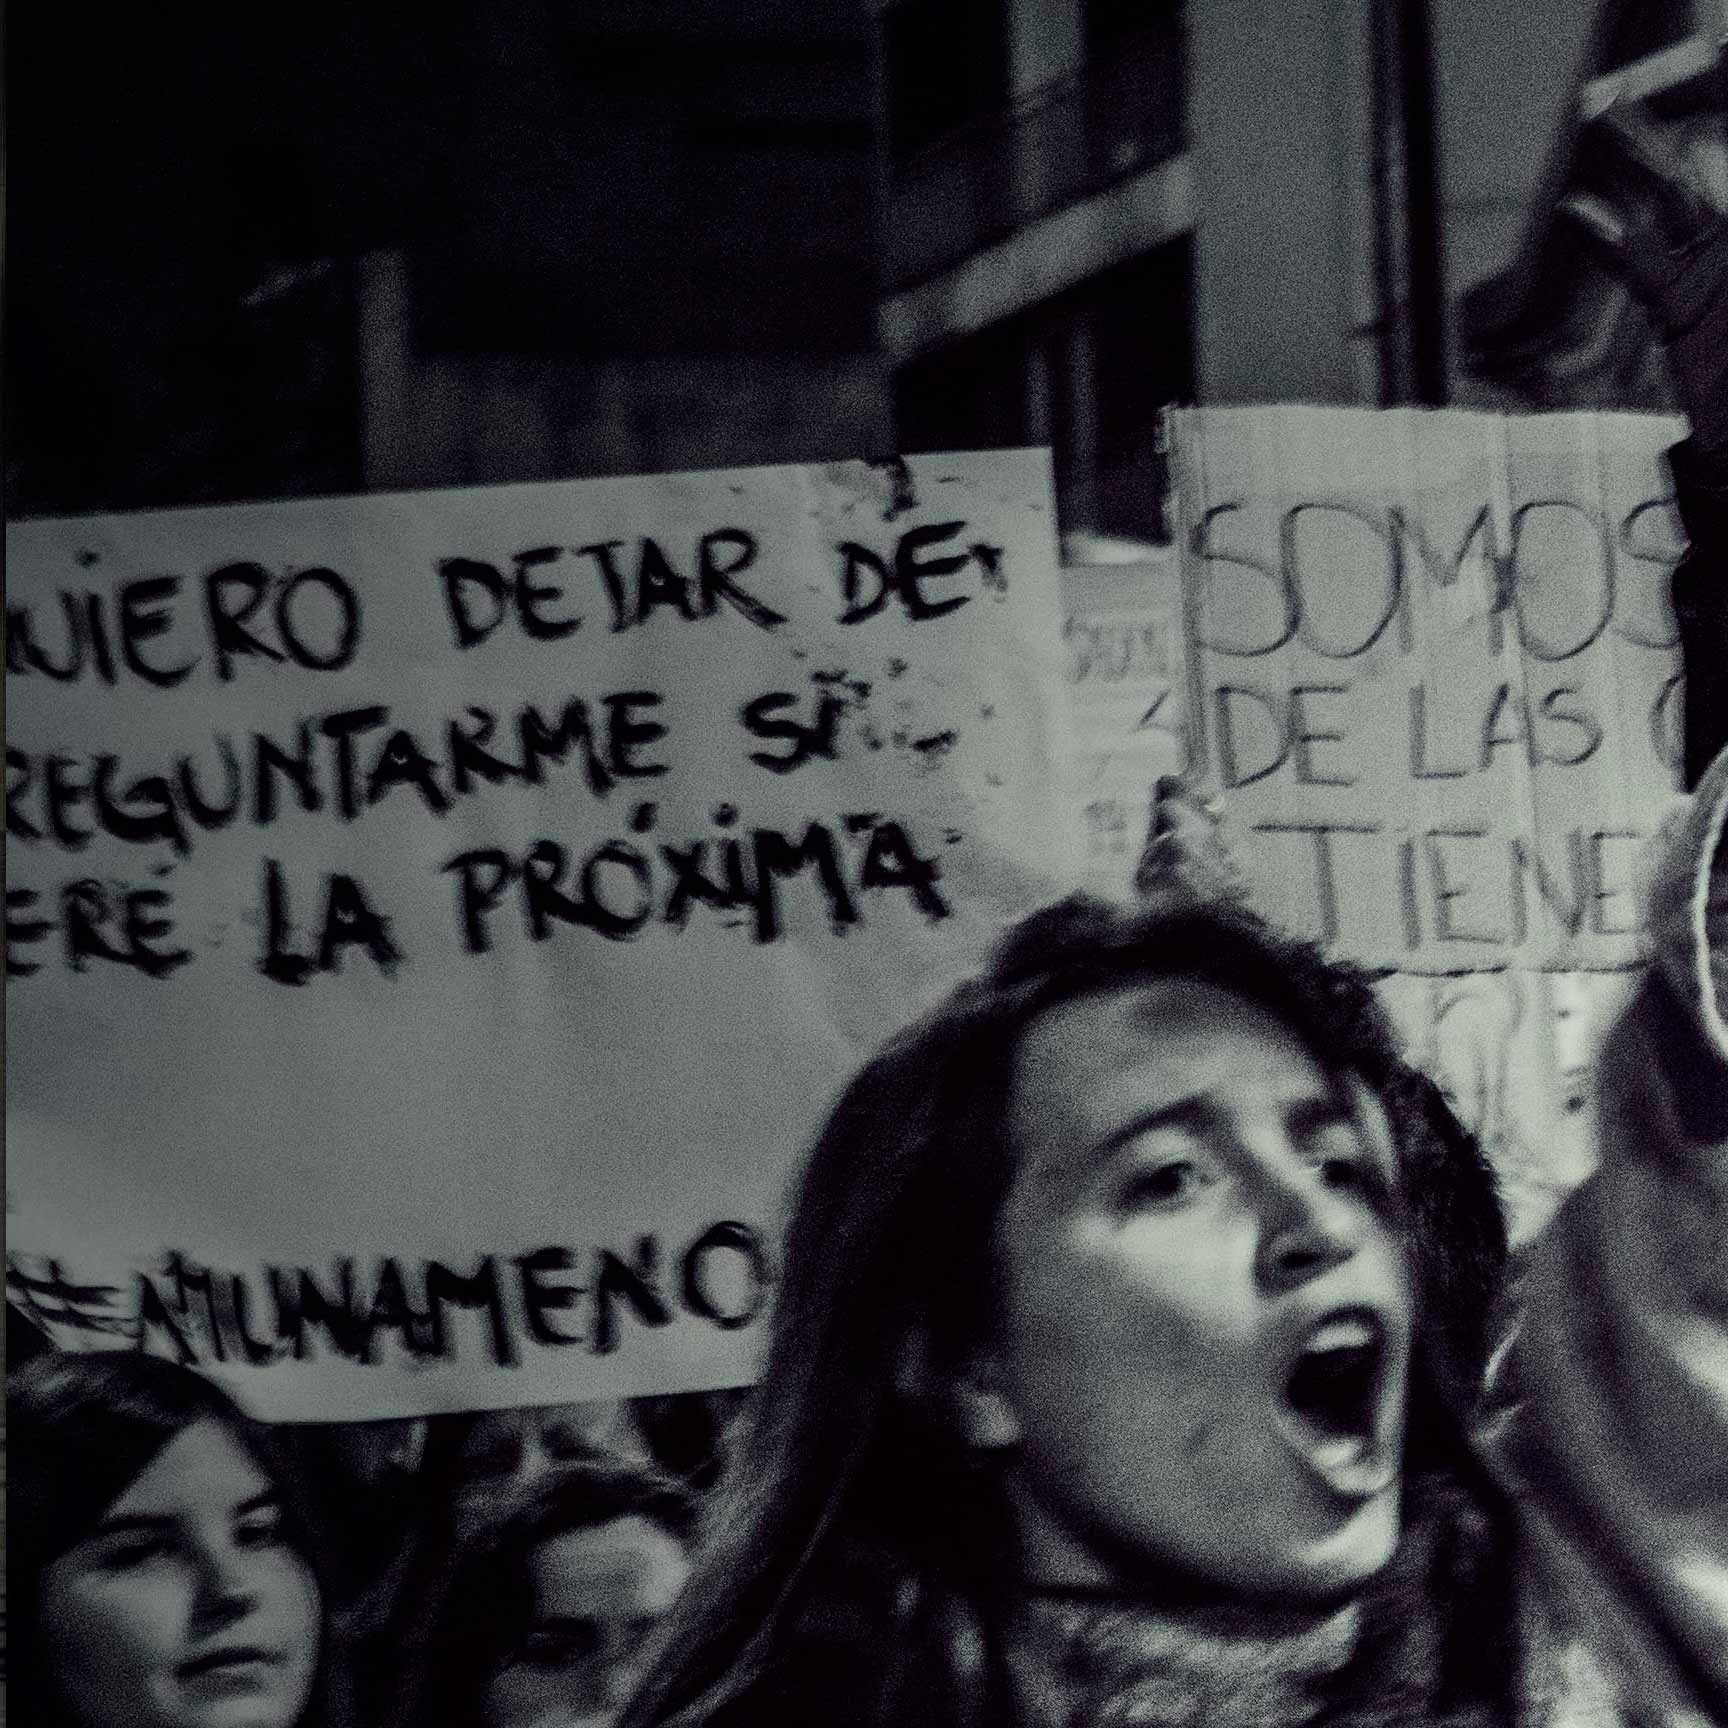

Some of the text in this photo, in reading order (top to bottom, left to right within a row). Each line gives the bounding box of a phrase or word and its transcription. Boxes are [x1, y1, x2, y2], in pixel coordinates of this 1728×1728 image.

[6, 549, 362, 690] UIERO
[1214, 683, 1361, 790] DE
[1408, 683, 1604, 784] LAS
[252, 855, 406, 988] LA
